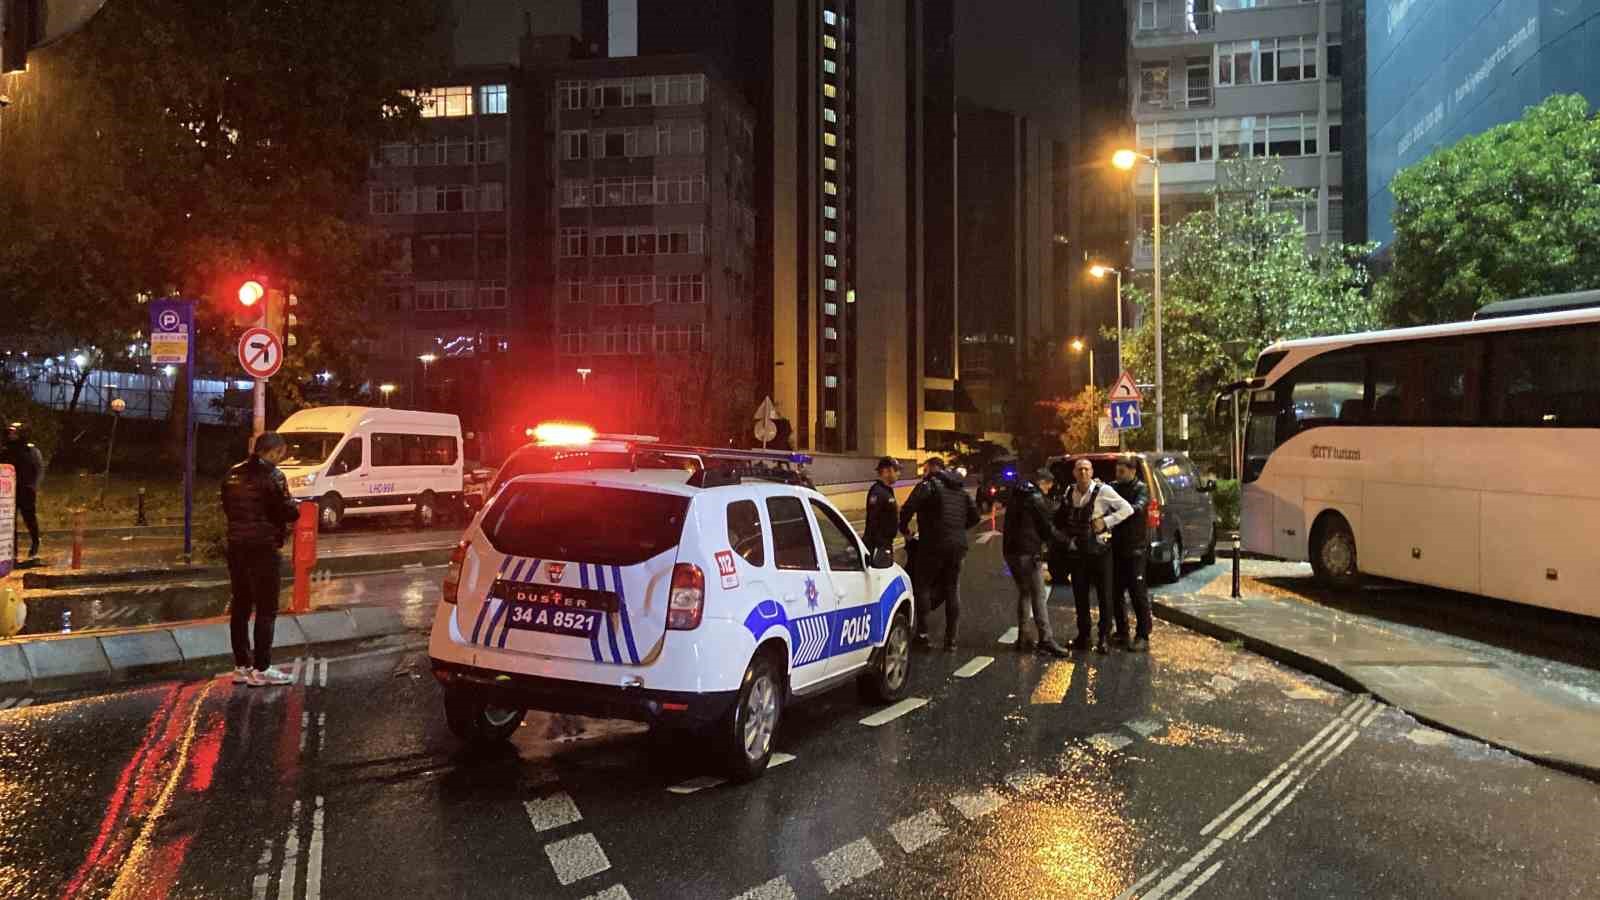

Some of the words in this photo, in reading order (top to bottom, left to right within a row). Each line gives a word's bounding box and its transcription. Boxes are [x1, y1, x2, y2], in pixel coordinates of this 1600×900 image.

[717, 555, 734, 574] 112
[517, 591, 587, 608] DUSTER
[512, 606, 533, 624] 34
[535, 609, 549, 626] A
[553, 611, 594, 631] 8521
[840, 607, 871, 647] POLİS
